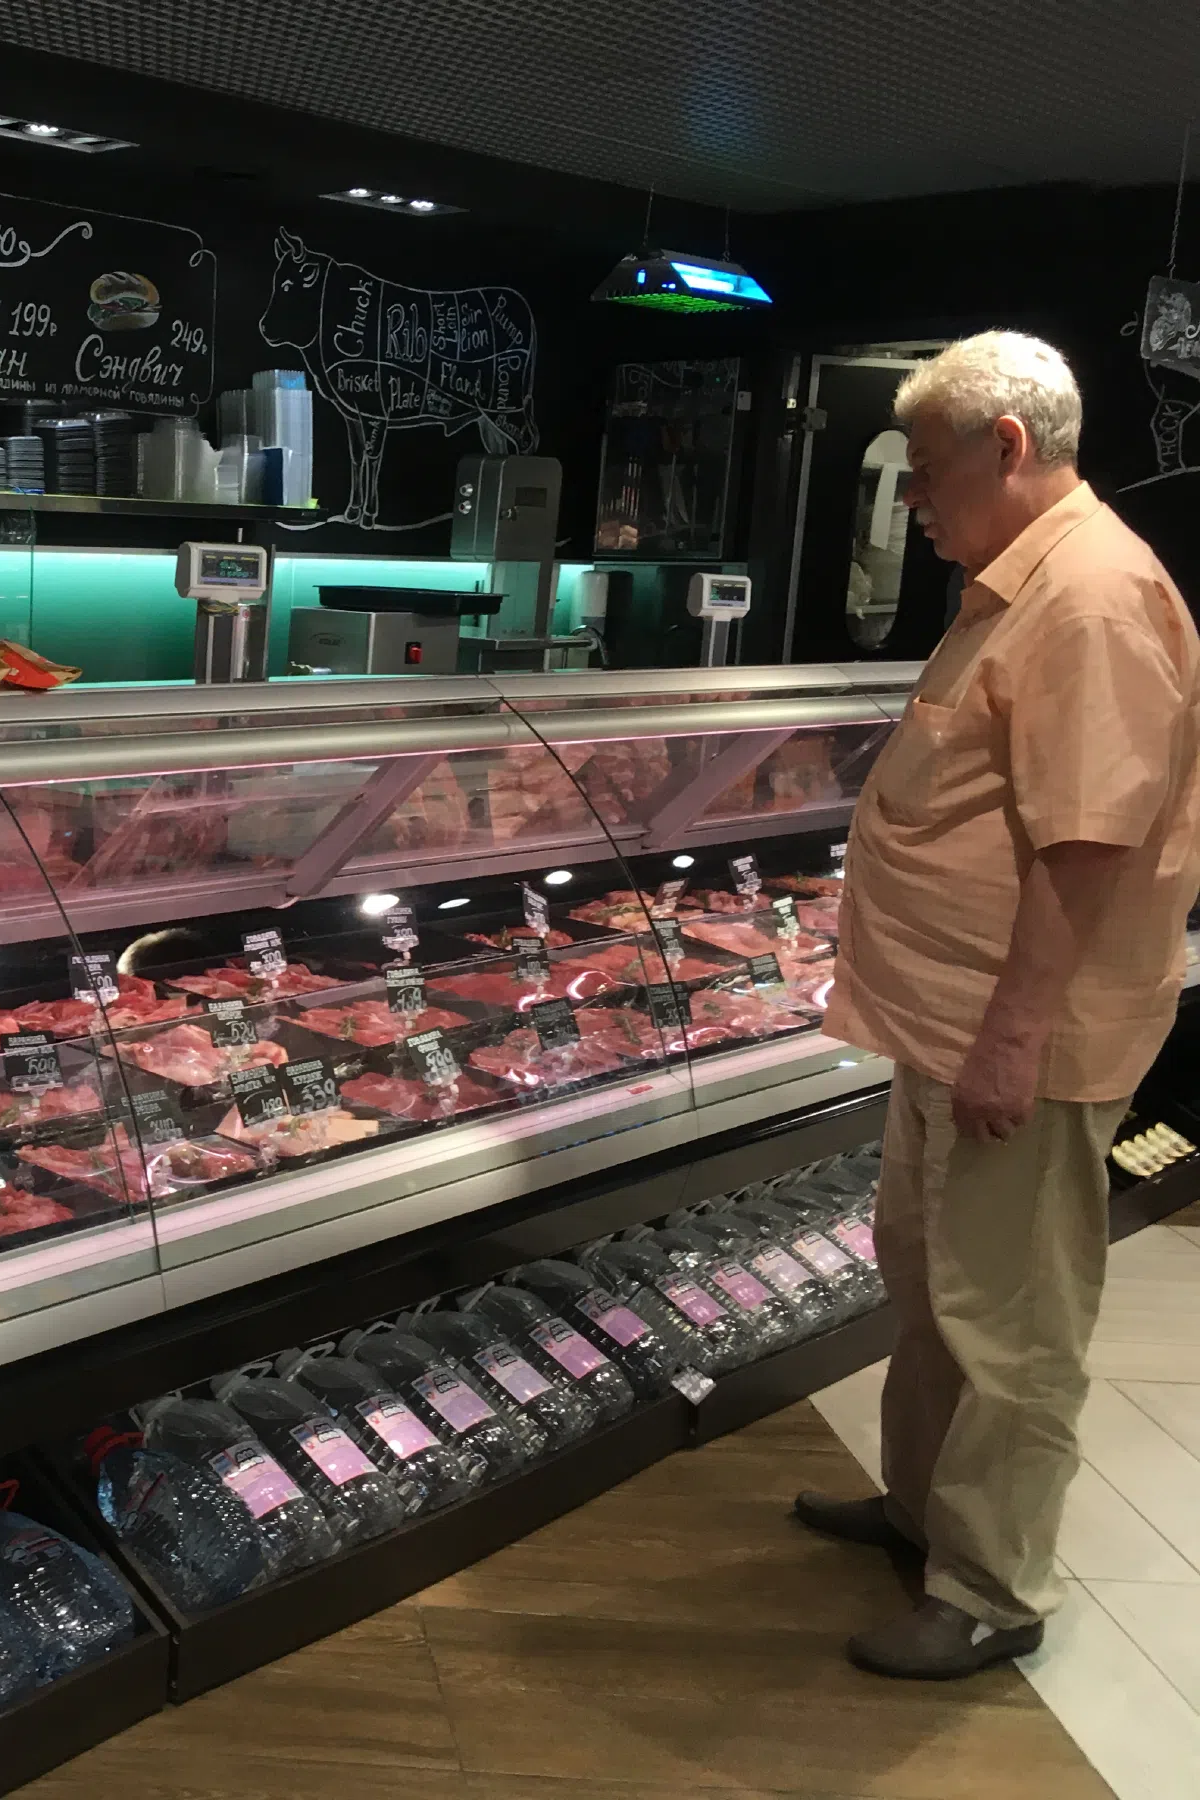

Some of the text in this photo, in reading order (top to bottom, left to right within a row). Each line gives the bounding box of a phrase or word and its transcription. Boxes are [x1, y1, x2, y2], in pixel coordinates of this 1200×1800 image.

[75, 333, 184, 391] Сэндвич
[385, 303, 428, 363] Rib
[337, 368, 379, 392] Brisket
